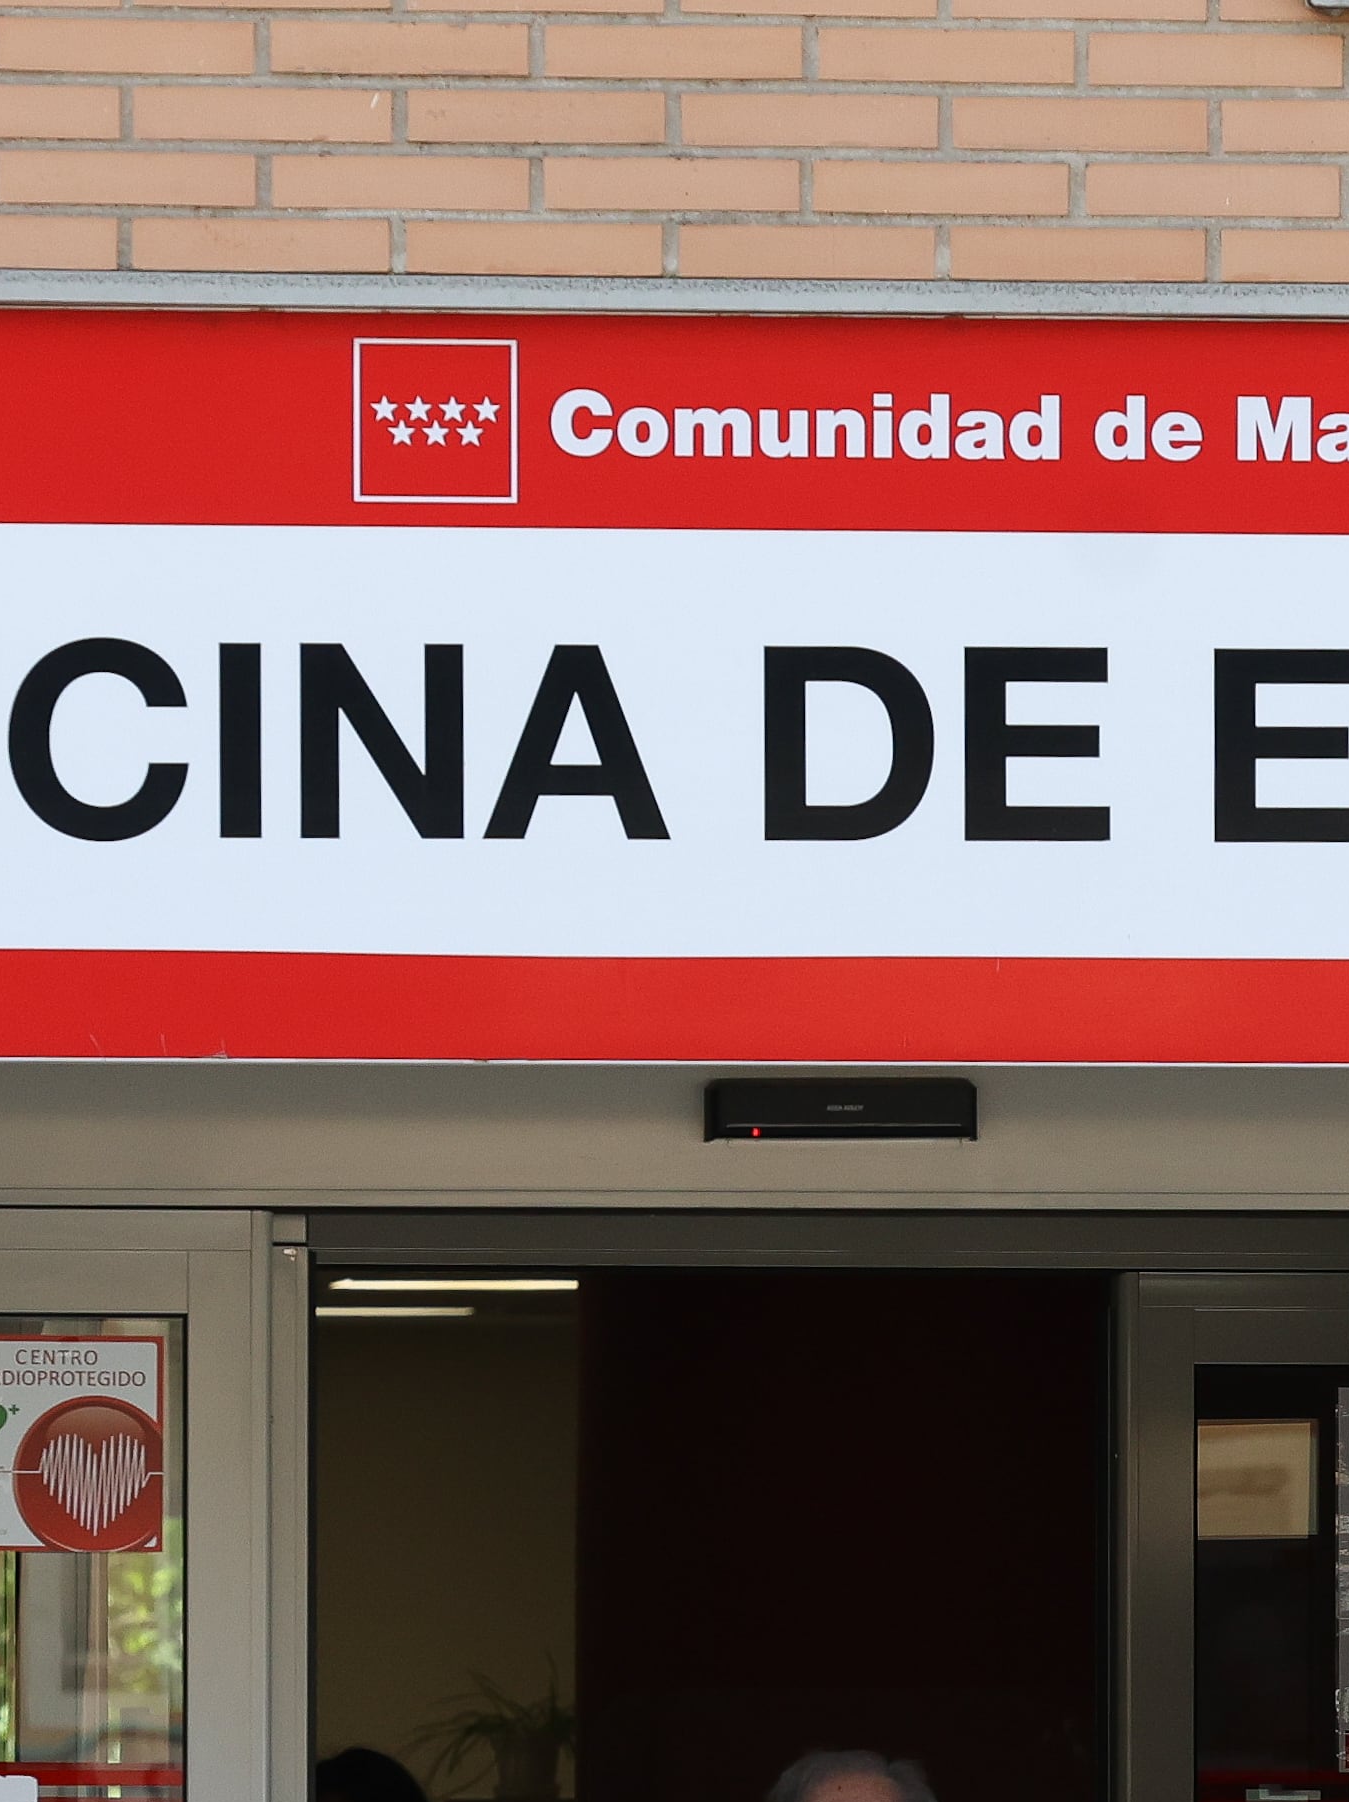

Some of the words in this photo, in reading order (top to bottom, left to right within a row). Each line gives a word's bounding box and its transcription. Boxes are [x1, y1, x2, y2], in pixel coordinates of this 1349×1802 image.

[549, 386, 1061, 468] Comunidad
[1093, 393, 1202, 463] de
[763, 645, 1111, 843] DE
[15, 1349, 98, 1365] CENTRO
